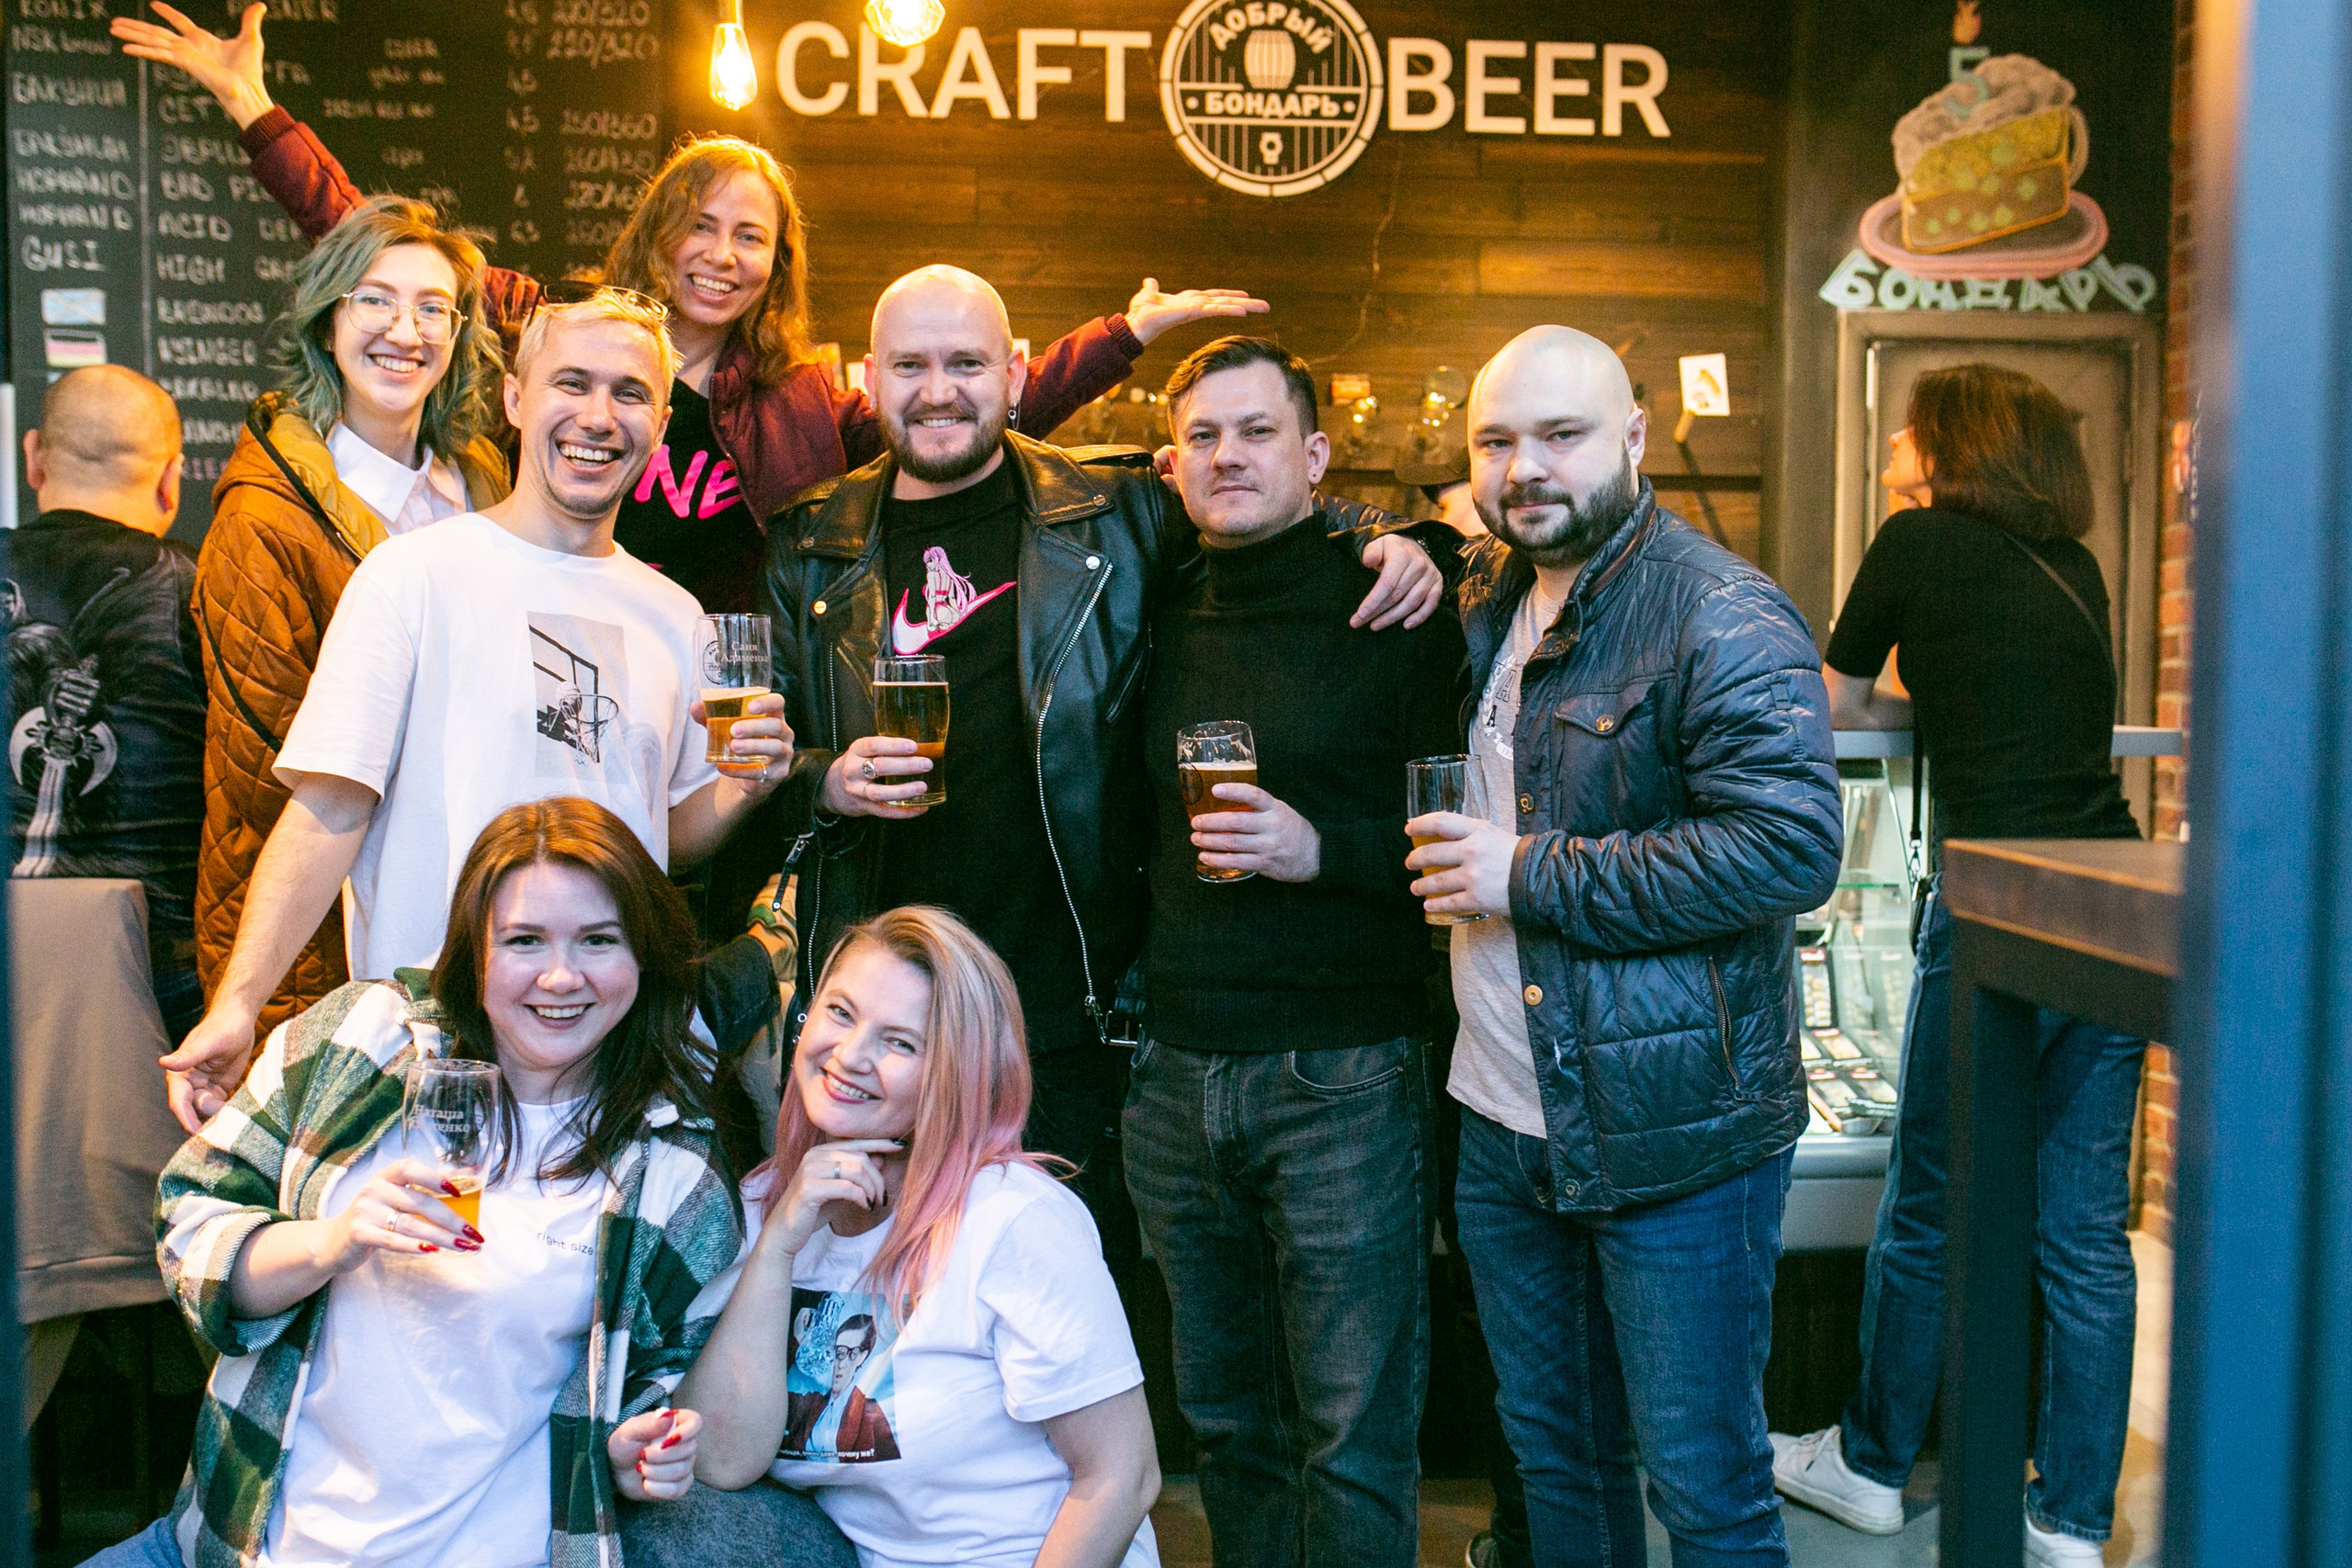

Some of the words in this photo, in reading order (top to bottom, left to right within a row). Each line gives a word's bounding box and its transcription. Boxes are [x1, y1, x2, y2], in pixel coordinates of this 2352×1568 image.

[1208, 2, 1334, 54] ДОБРЫЙ
[775, 21, 1152, 122] CRAFT
[1387, 37, 1671, 138] BEER
[1204, 92, 1340, 118] БОНДАРЬ
[537, 1230, 567, 1249] right
[571, 1242, 594, 1256] size
